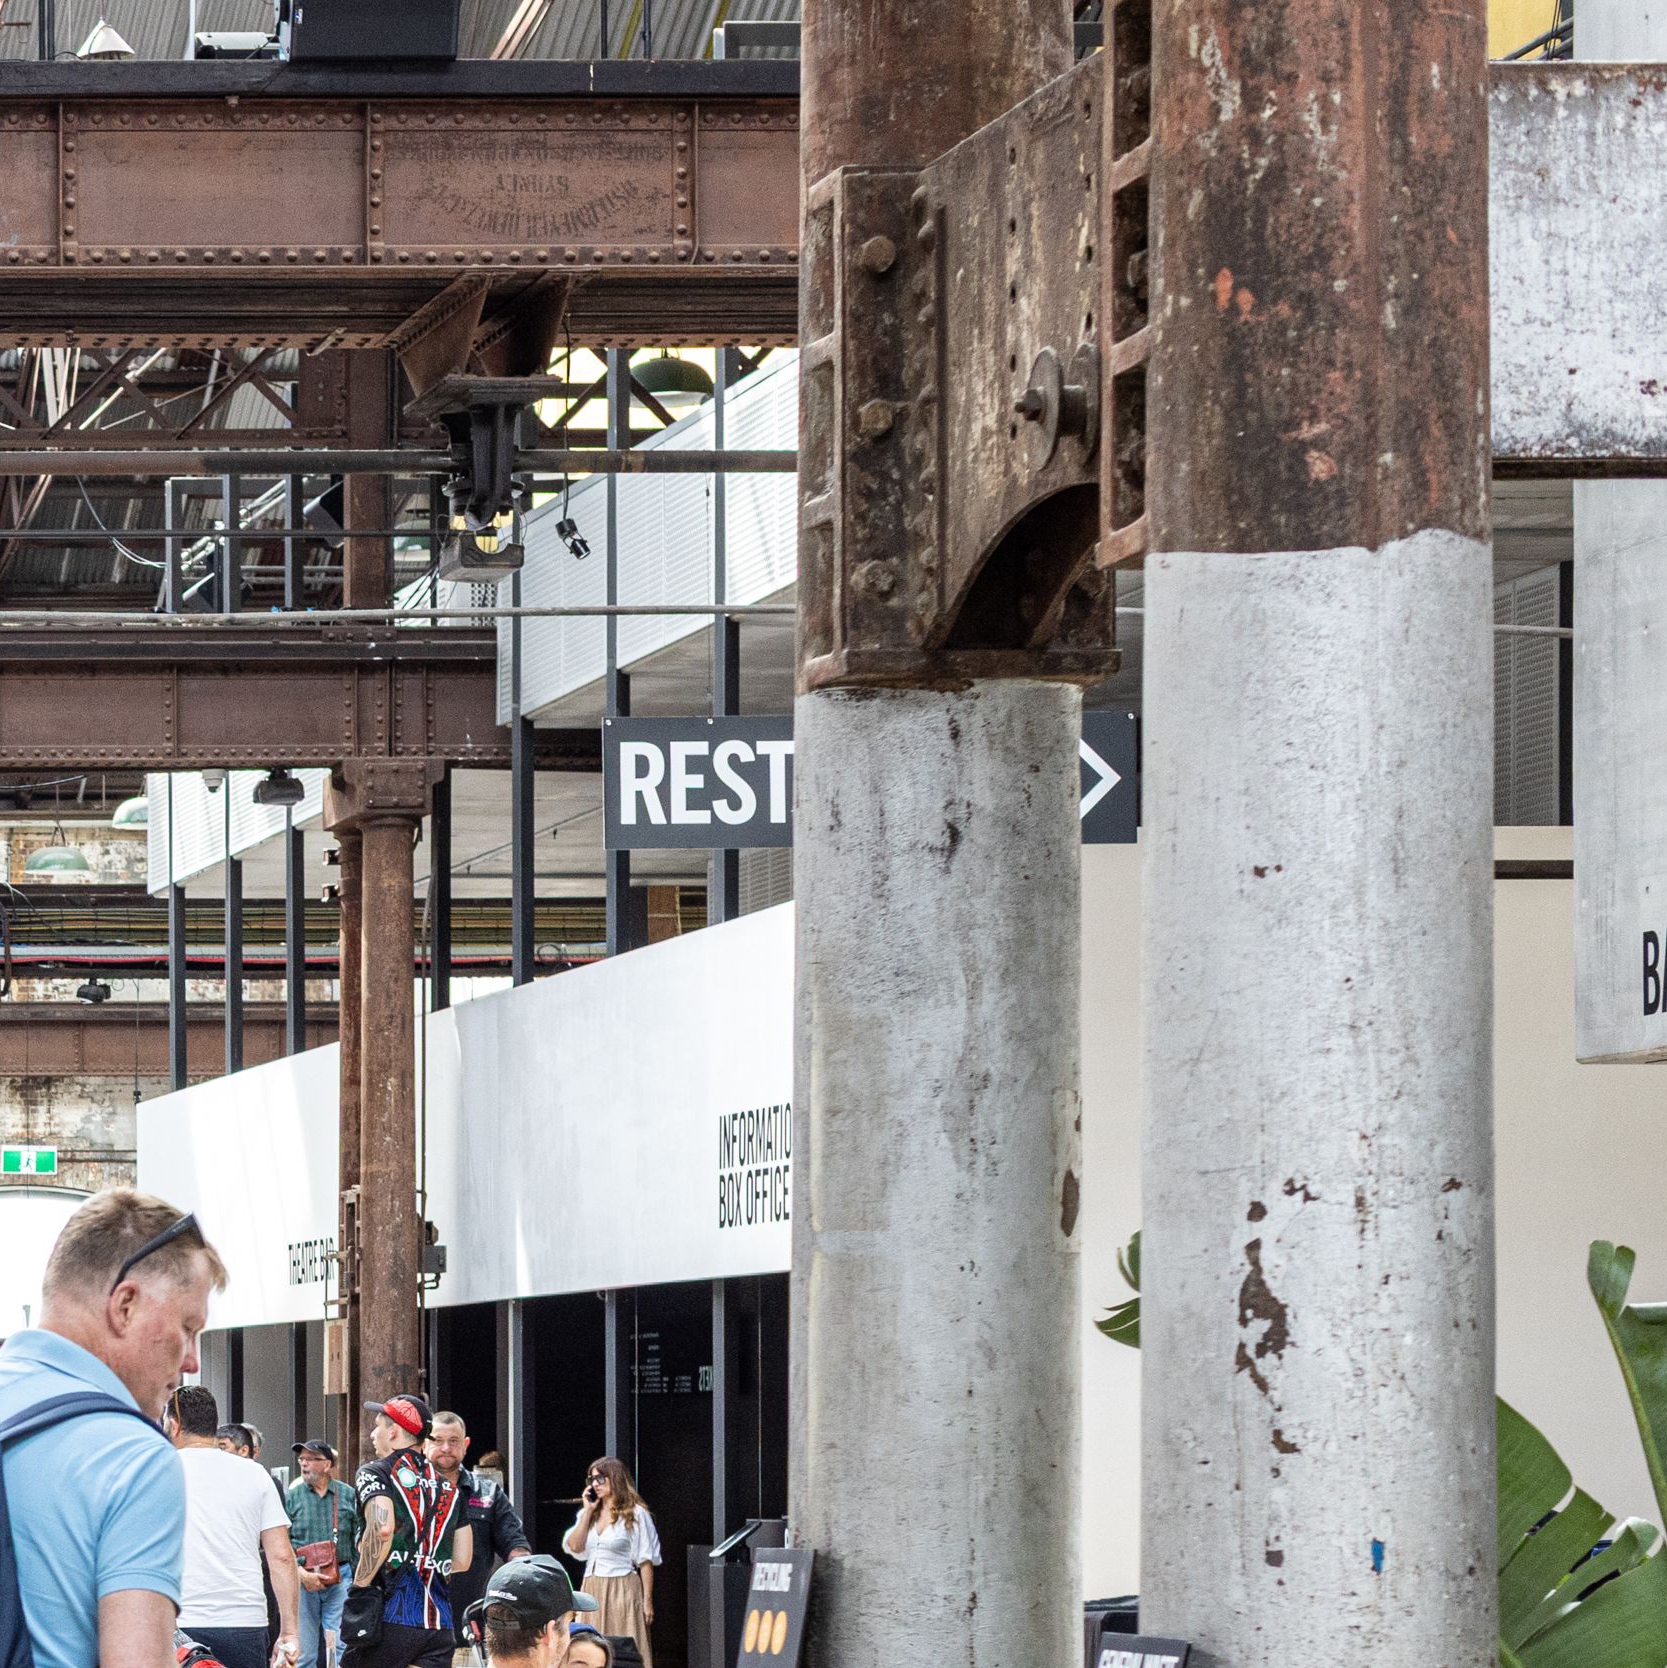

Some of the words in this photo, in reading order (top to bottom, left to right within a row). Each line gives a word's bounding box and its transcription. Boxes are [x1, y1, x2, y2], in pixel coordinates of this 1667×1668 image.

[620, 740, 794, 825] REST
[719, 1102, 792, 1170] INFORMATIO
[719, 1171, 743, 1229] BOX
[746, 1164, 791, 1226] OFFICE
[288, 1238, 318, 1286] THEATRE
